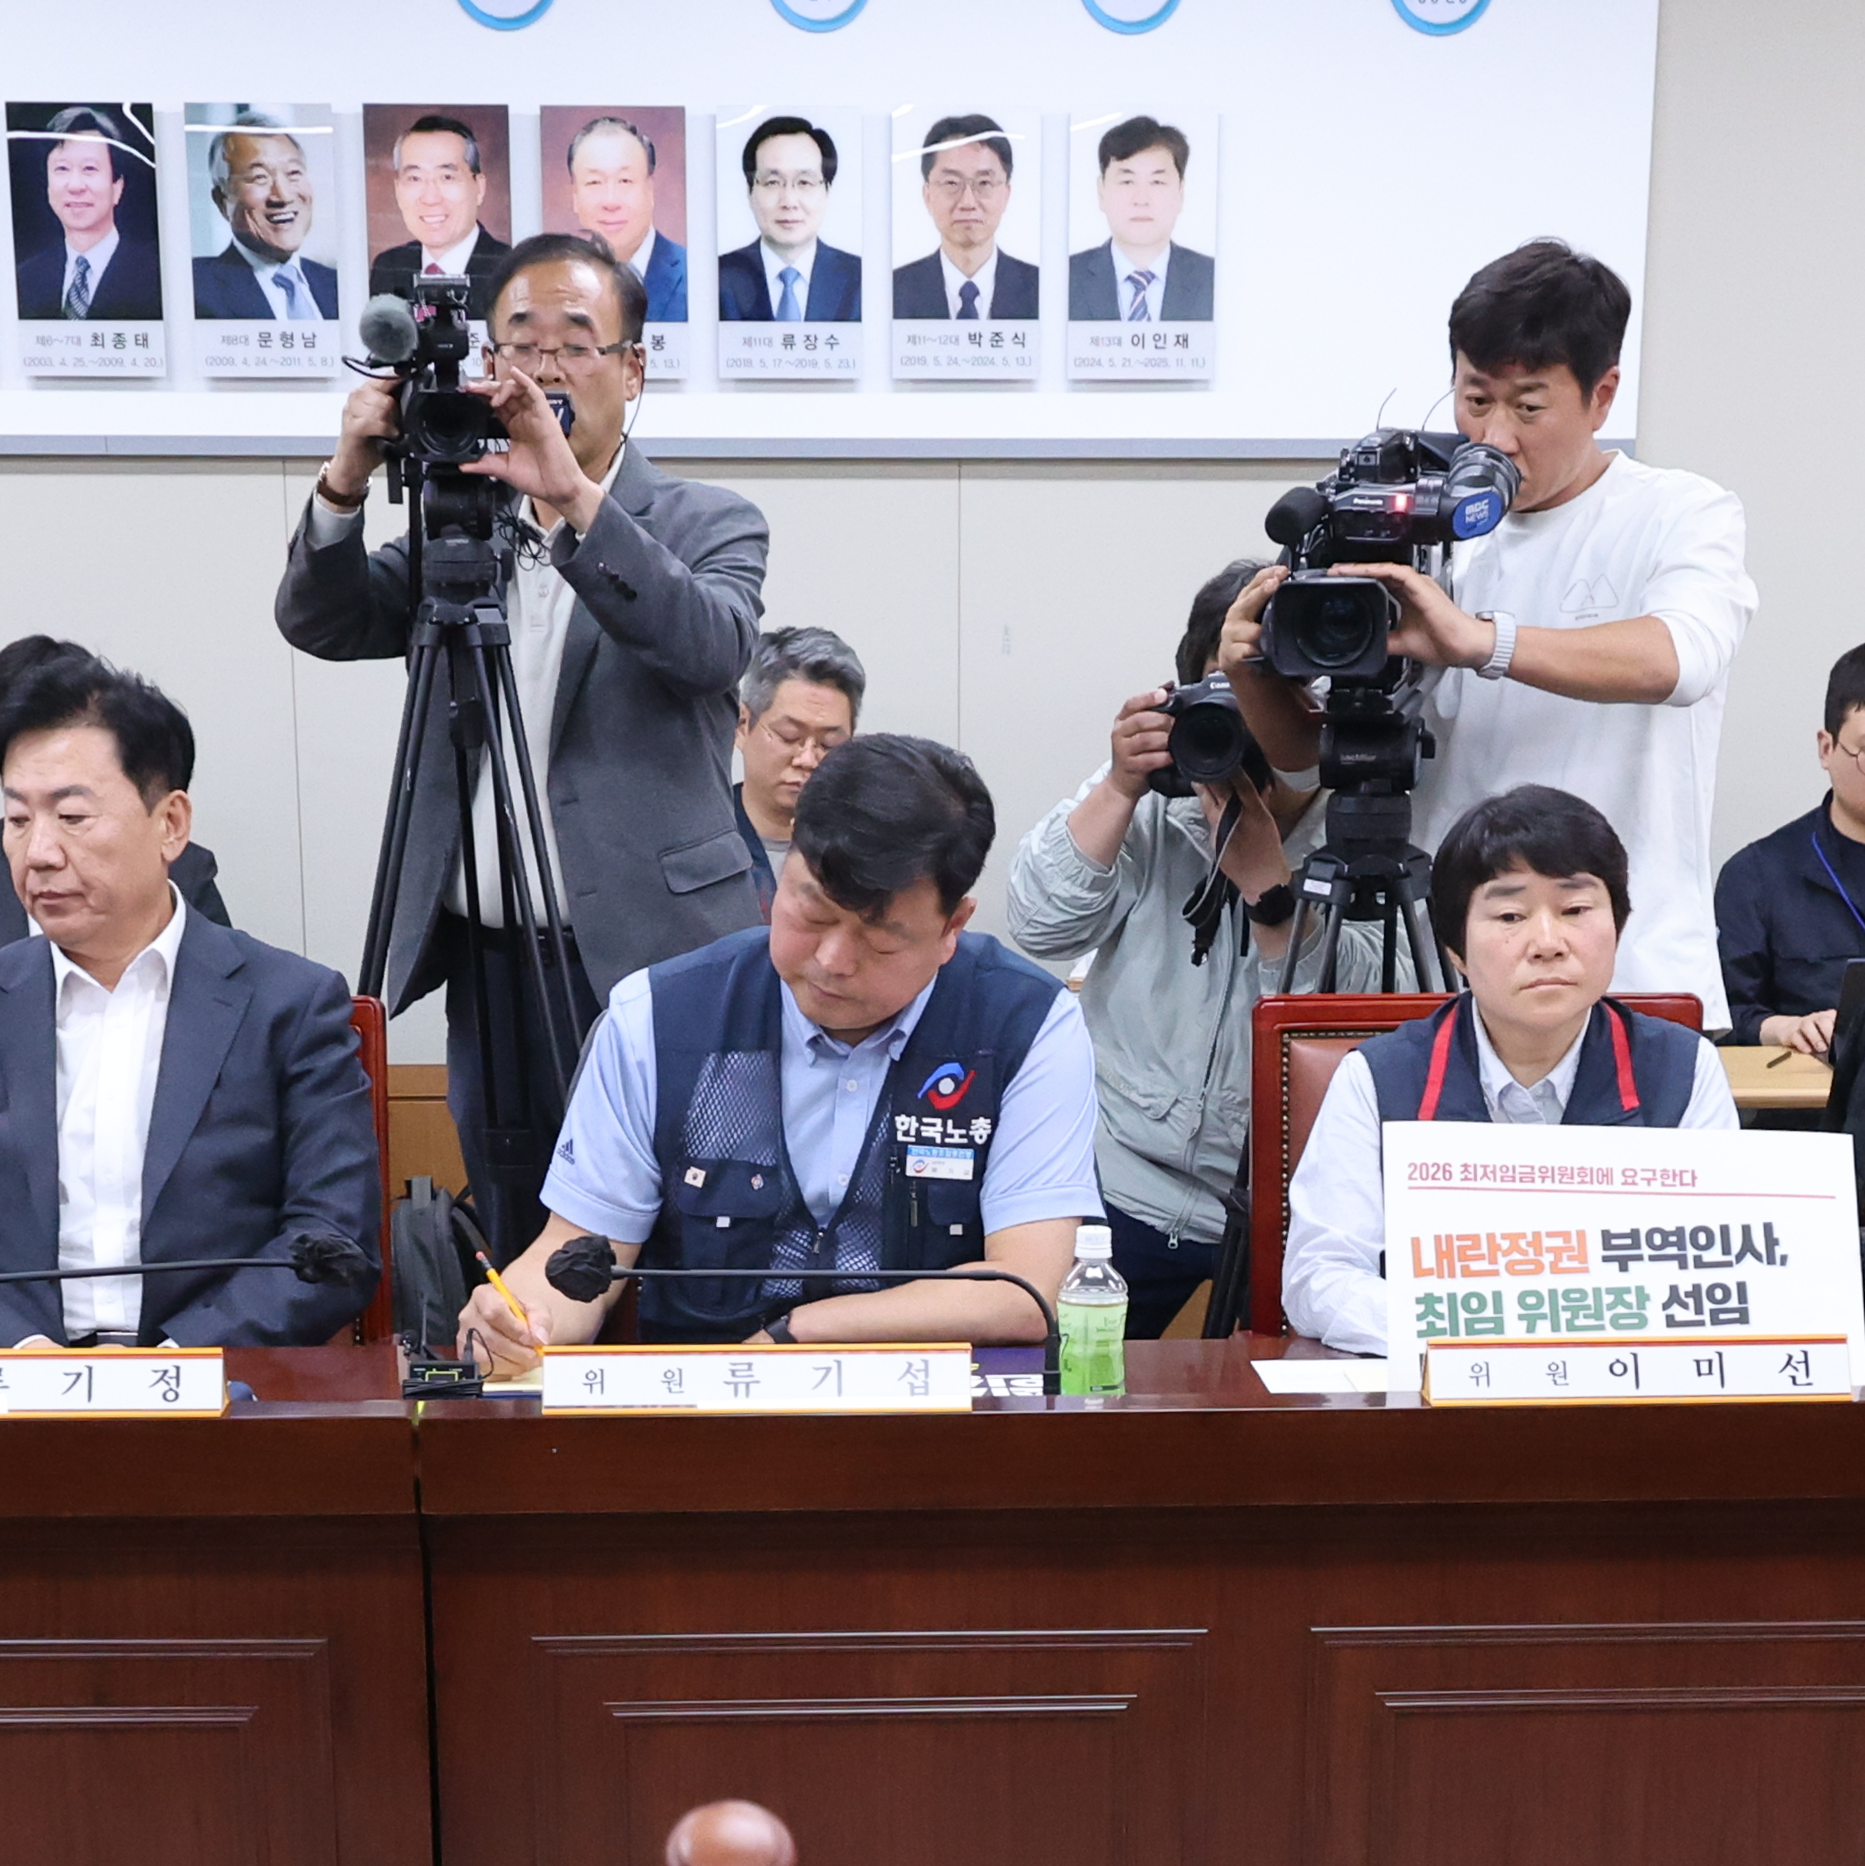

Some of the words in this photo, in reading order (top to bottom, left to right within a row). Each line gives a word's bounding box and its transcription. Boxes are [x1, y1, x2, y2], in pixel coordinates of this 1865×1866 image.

[781, 333, 840, 351] 류장수
[968, 331, 1027, 349] 박준식
[1131, 333, 1190, 350] 이인재
[894, 1114, 992, 1145] 한국노총
[1407, 1162, 1453, 1183] 2026
[1459, 1163, 1614, 1187] 최저임금위원회에
[1620, 1168, 1698, 1188] 요구한다
[1411, 1229, 1590, 1279] 내란정권
[1600, 1222, 1789, 1272] 부역인사,
[1415, 1289, 1505, 1338] 최임
[1517, 1285, 1651, 1333] 위원장
[1661, 1281, 1750, 1328] 선임
[722, 1359, 931, 1398] 류기섭
[1608, 1349, 1815, 1391] 이미선
